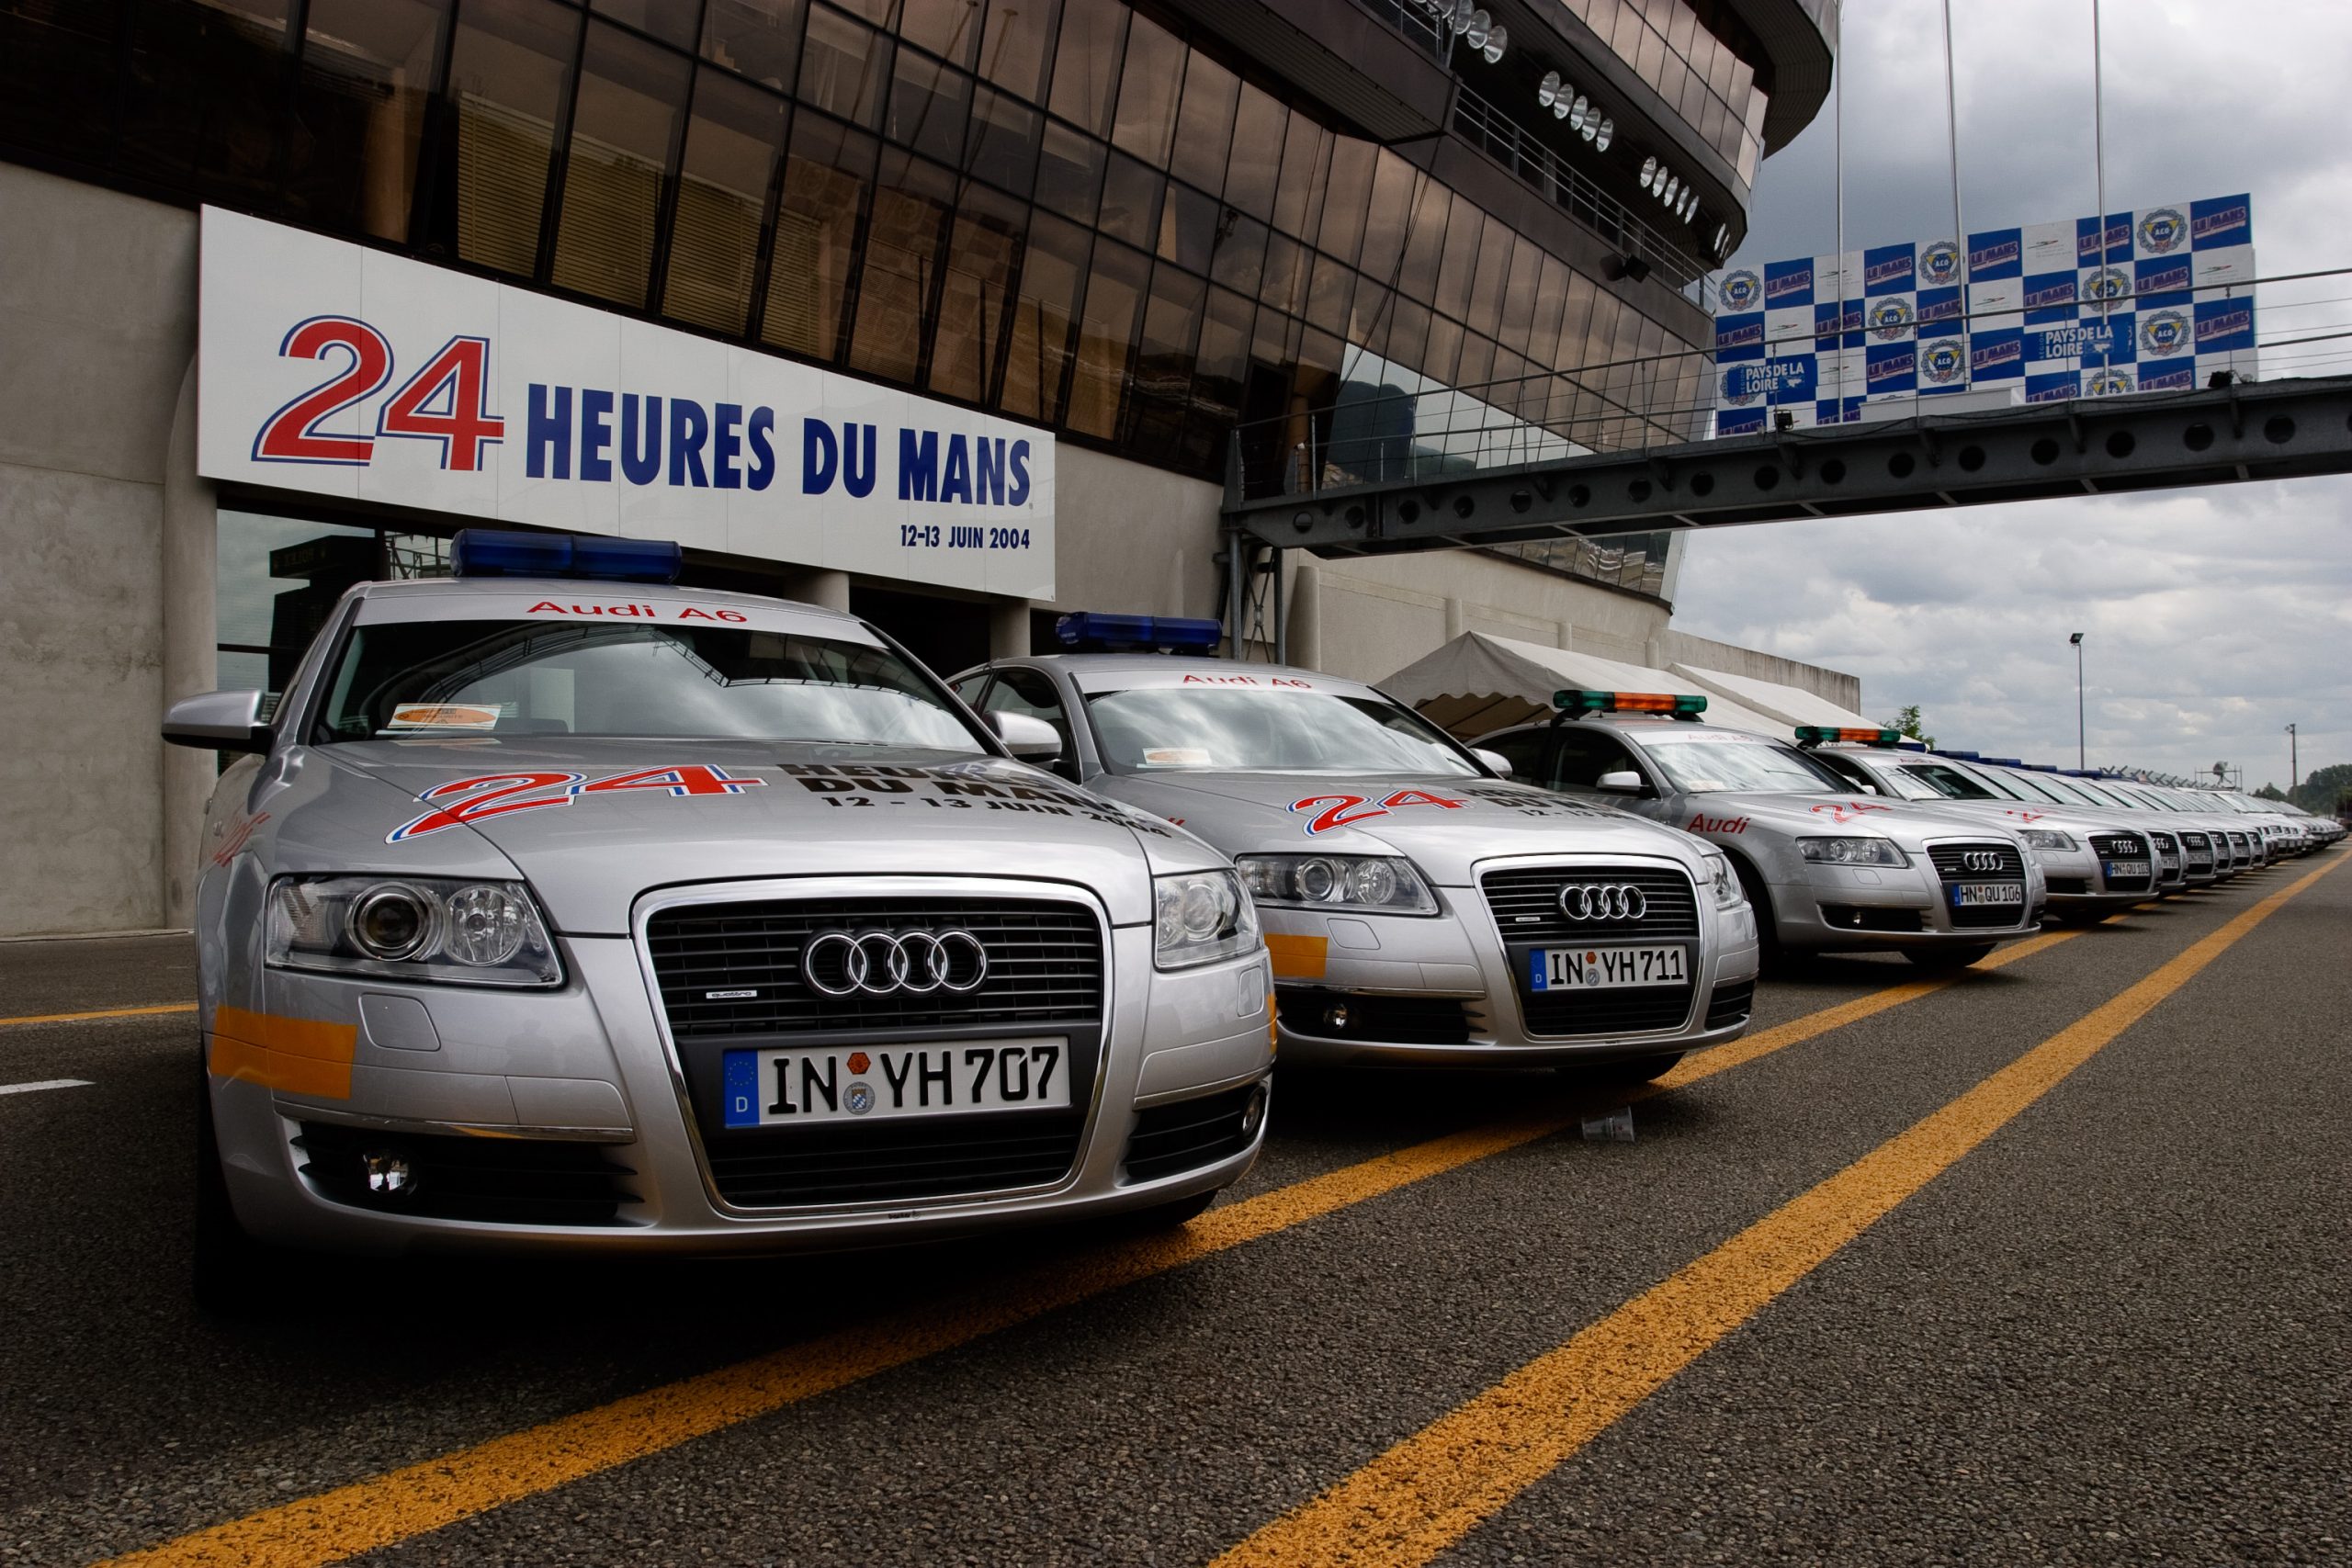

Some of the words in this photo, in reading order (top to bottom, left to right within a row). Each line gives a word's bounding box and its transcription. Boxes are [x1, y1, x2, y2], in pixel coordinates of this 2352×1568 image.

[2193, 220, 2208, 235] LE
[2209, 207, 2246, 230] MANS
[1969, 251, 1984, 267] LE
[1984, 241, 2018, 263] MANS
[1865, 265, 1879, 281] LE
[1879, 256, 1912, 276] MANS
[2136, 279, 2152, 293] LE
[2153, 266, 2188, 288] MANS
[1765, 279, 1780, 294] LE
[1781, 270, 1811, 288] MANS
[2024, 293, 2039, 308] LE
[2040, 283, 2074, 304] MANS
[1718, 331, 1732, 347] LE
[1733, 323, 1762, 343] MANS
[2045, 329, 2076, 344] PAYS
[2077, 327, 2095, 341] DE
[2096, 325, 2113, 339] LA
[2196, 321, 2211, 336] LE
[2211, 310, 2250, 333] MANS
[1972, 350, 1985, 366] LE
[1986, 340, 2020, 361] MANS
[2045, 342, 2084, 358] LOIRE
[1746, 366, 1772, 380] PAYS
[1773, 363, 1789, 378] DE
[1789, 361, 1804, 375] LA
[1867, 362, 1882, 378] LE
[1883, 354, 1914, 373] MANS
[1746, 378, 1779, 393] LOIRE
[250, 314, 504, 472] 24
[526, 382, 775, 492] HEURES
[802, 417, 877, 499] DU
[898, 427, 1031, 507] MANS
[900, 525, 941, 548] 12-13
[948, 525, 984, 549] JUIN
[989, 527, 1031, 550] 2004
[526, 602, 656, 617] Audi
[678, 607, 748, 624] A6
[1183, 674, 1260, 686] Audi
[1272, 677, 1312, 689] A6
[796, 777, 914, 794] DU
[384, 763, 770, 845] 24
[1286, 788, 1477, 839] 24
[1482, 797, 1553, 808] DU
[821, 796, 876, 808] 12
[919, 797, 973, 810] 13
[986, 799, 1074, 817] JUIN
[1080, 810, 1172, 839] 2004
[1687, 813, 1750, 835] Audi
[1961, 886, 1978, 903] HN
[1984, 886, 2000, 902] QU
[2002, 886, 2021, 902] 106
[1535, 973, 1543, 984] D
[1551, 953, 1584, 986] IN
[769, 1055, 838, 1114] IN
[735, 1097, 748, 1112] D
